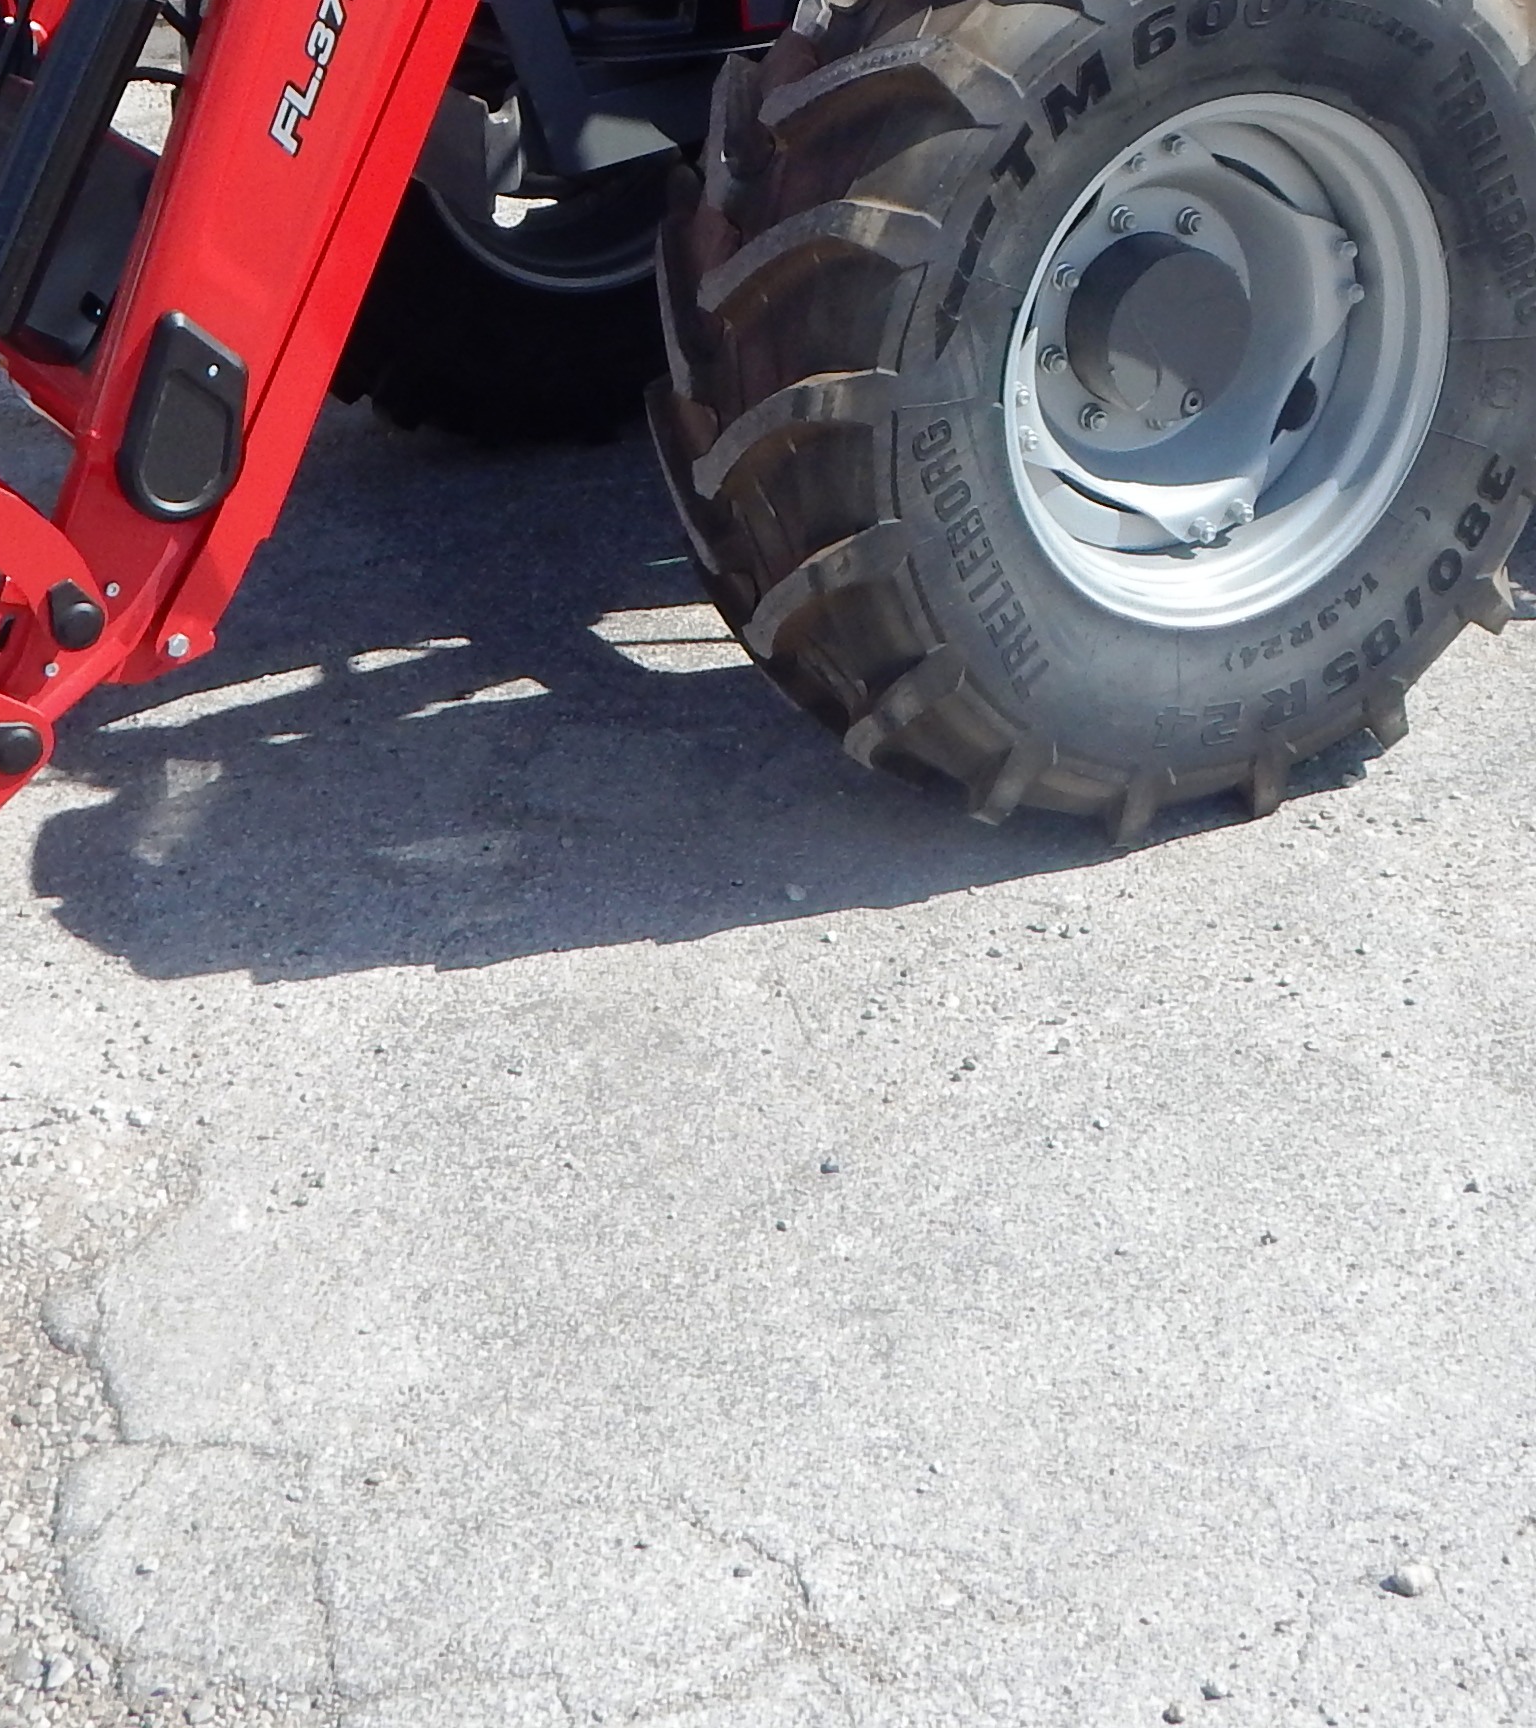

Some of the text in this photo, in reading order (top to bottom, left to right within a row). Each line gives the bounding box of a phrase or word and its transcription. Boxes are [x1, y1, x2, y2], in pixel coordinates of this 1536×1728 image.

[990, 48, 1113, 191] TM
[912, 418, 1050, 704] TRELLEBORG
[1154, 453, 1516, 749] 380/85 R 24
